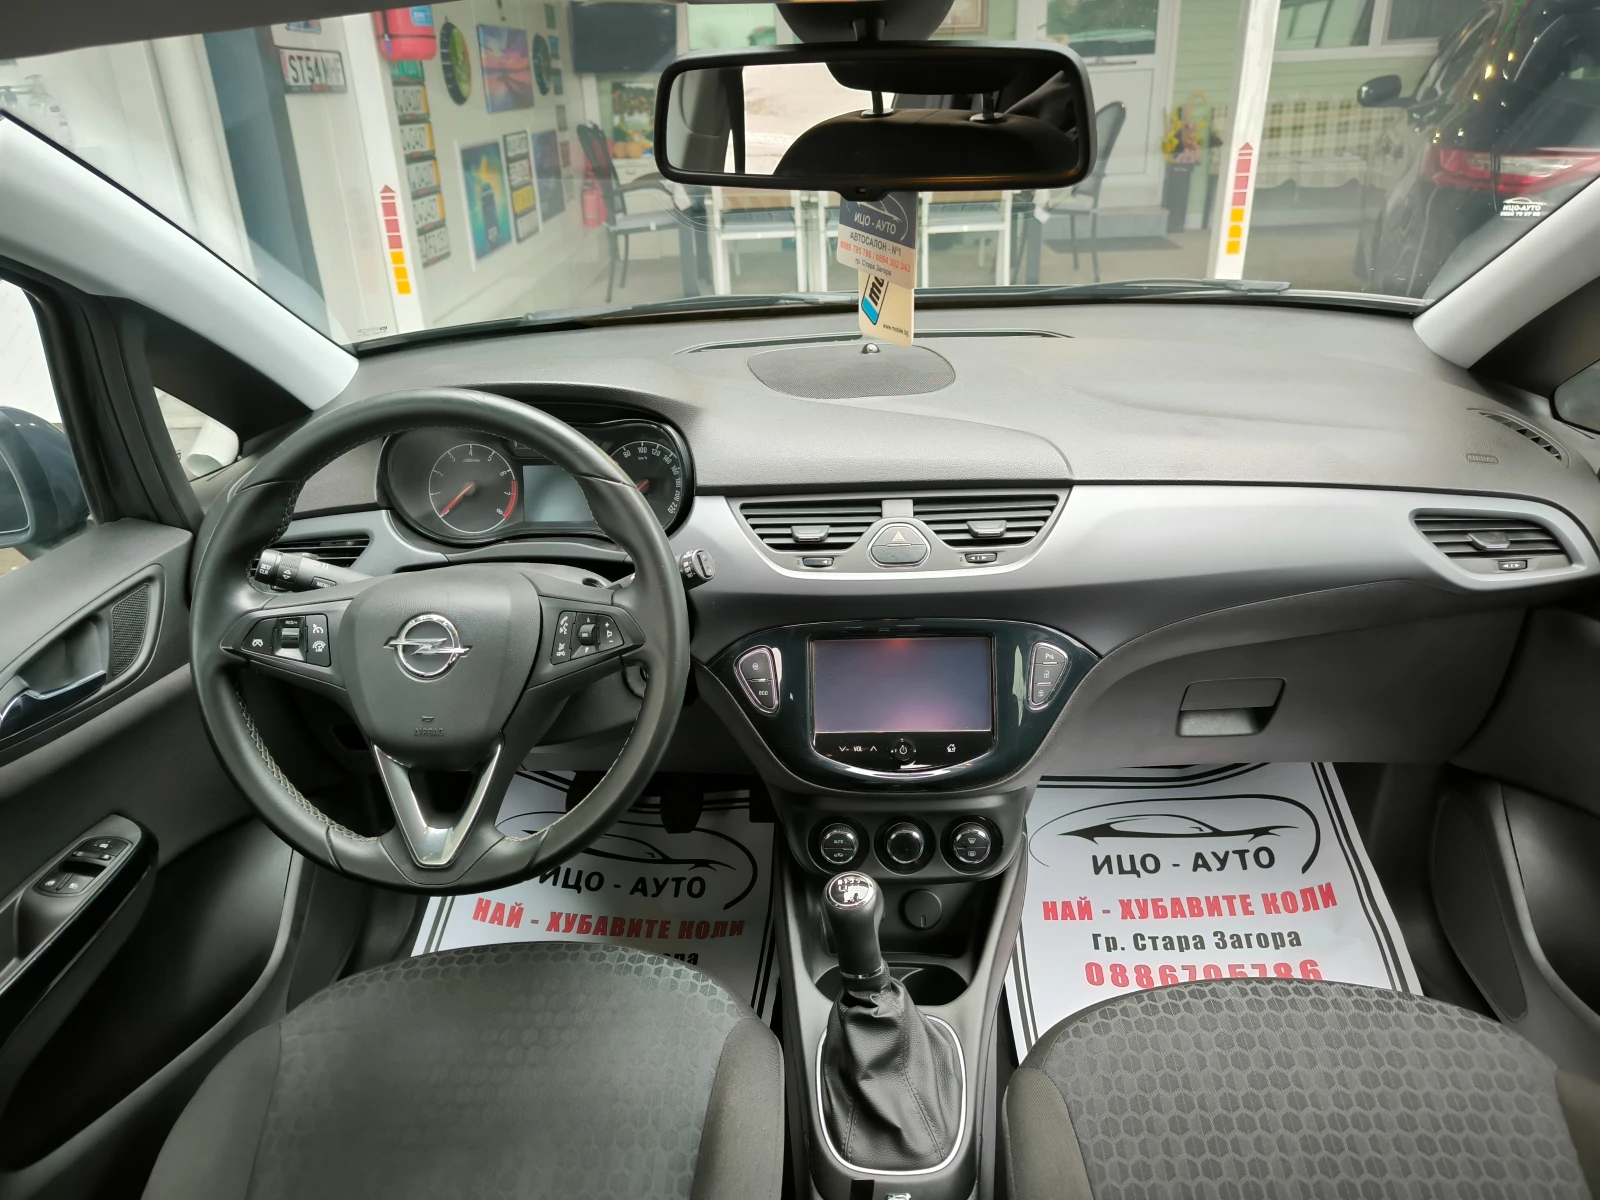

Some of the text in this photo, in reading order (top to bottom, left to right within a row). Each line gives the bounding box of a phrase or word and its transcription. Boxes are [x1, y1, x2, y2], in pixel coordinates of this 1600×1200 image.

[854, 211, 870, 227] ИЦО
[876, 219, 897, 235] АУТО
[850, 231, 887, 251] АВТОСАЛОН
[622, 449, 632, 458] 80
[637, 446, 648, 454] 100
[651, 448, 661, 457] 120
[663, 454, 673, 465] 140
[1091, 853, 1161, 878] ИЦО
[1191, 846, 1276, 873] АУТО
[538, 865, 605, 894] ИЦО
[629, 876, 706, 898] АУТО
[1042, 896, 1093, 921] НАЙ
[1118, 894, 1256, 920] ХУБАВИТЕ
[1260, 881, 1338, 914] КОЛИ
[472, 897, 525, 928] НАЙ
[545, 911, 672, 940] ХУБАВИТЕ
[677, 919, 745, 940] КОЛИ
[1092, 930, 1303, 953] Гр. Стара Загора
